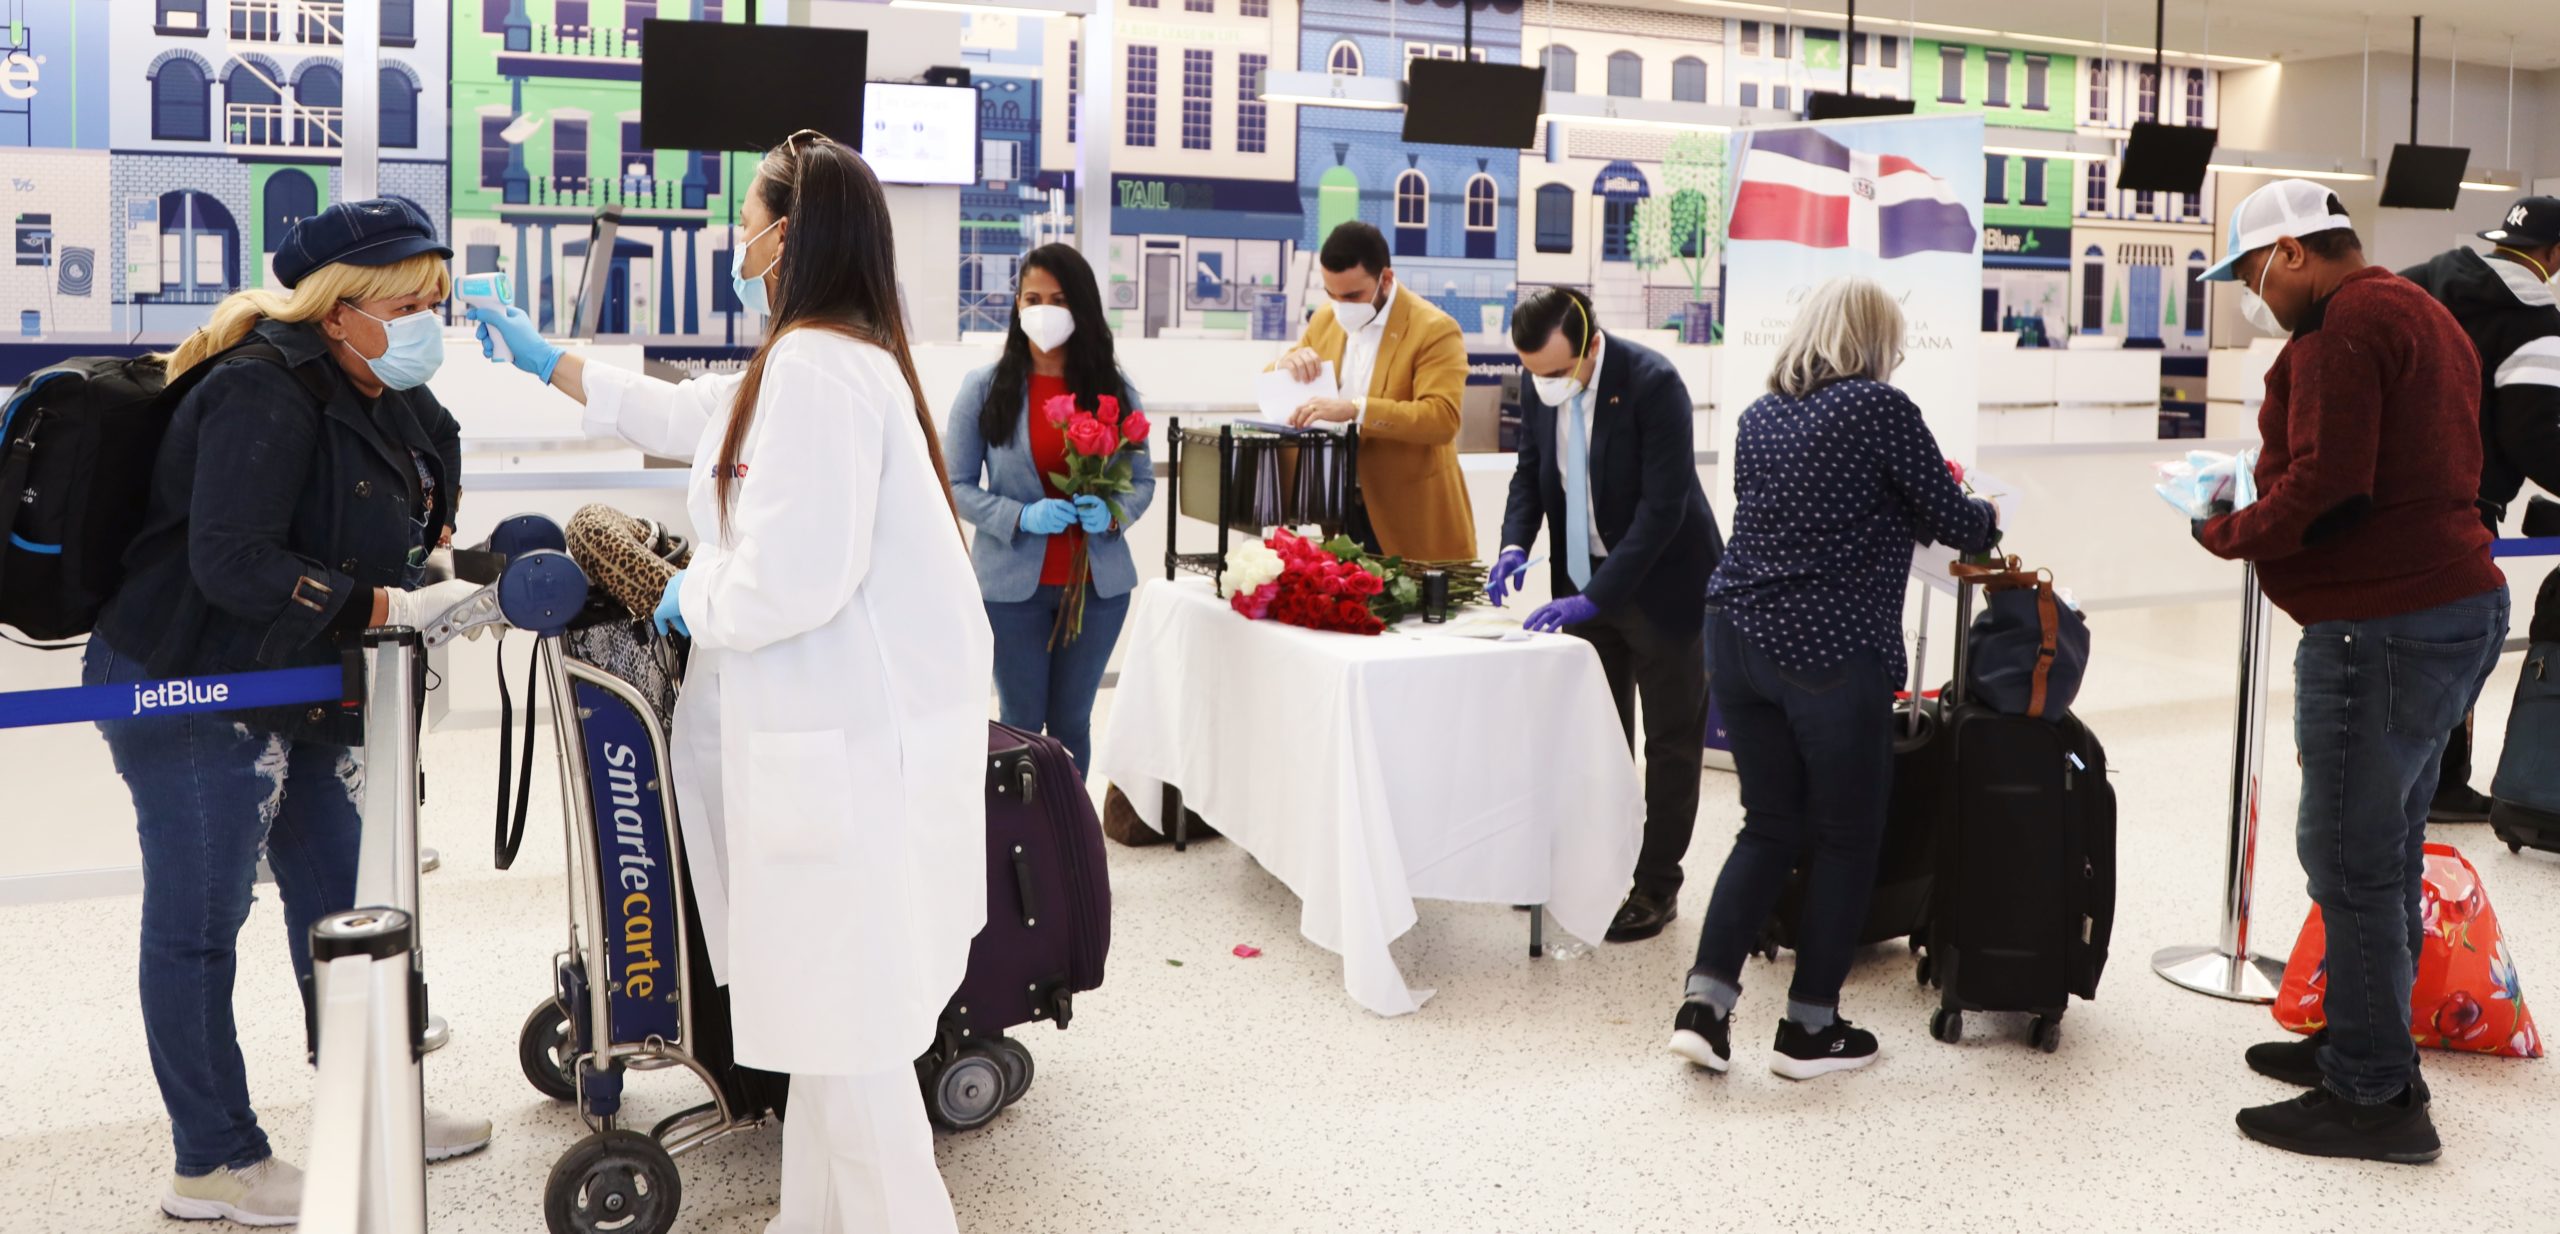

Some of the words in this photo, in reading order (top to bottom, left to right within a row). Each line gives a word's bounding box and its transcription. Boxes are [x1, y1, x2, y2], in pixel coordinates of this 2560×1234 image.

[0, 54, 39, 99] e
[708, 358, 750, 371] entra
[132, 680, 229, 715] jetBlue
